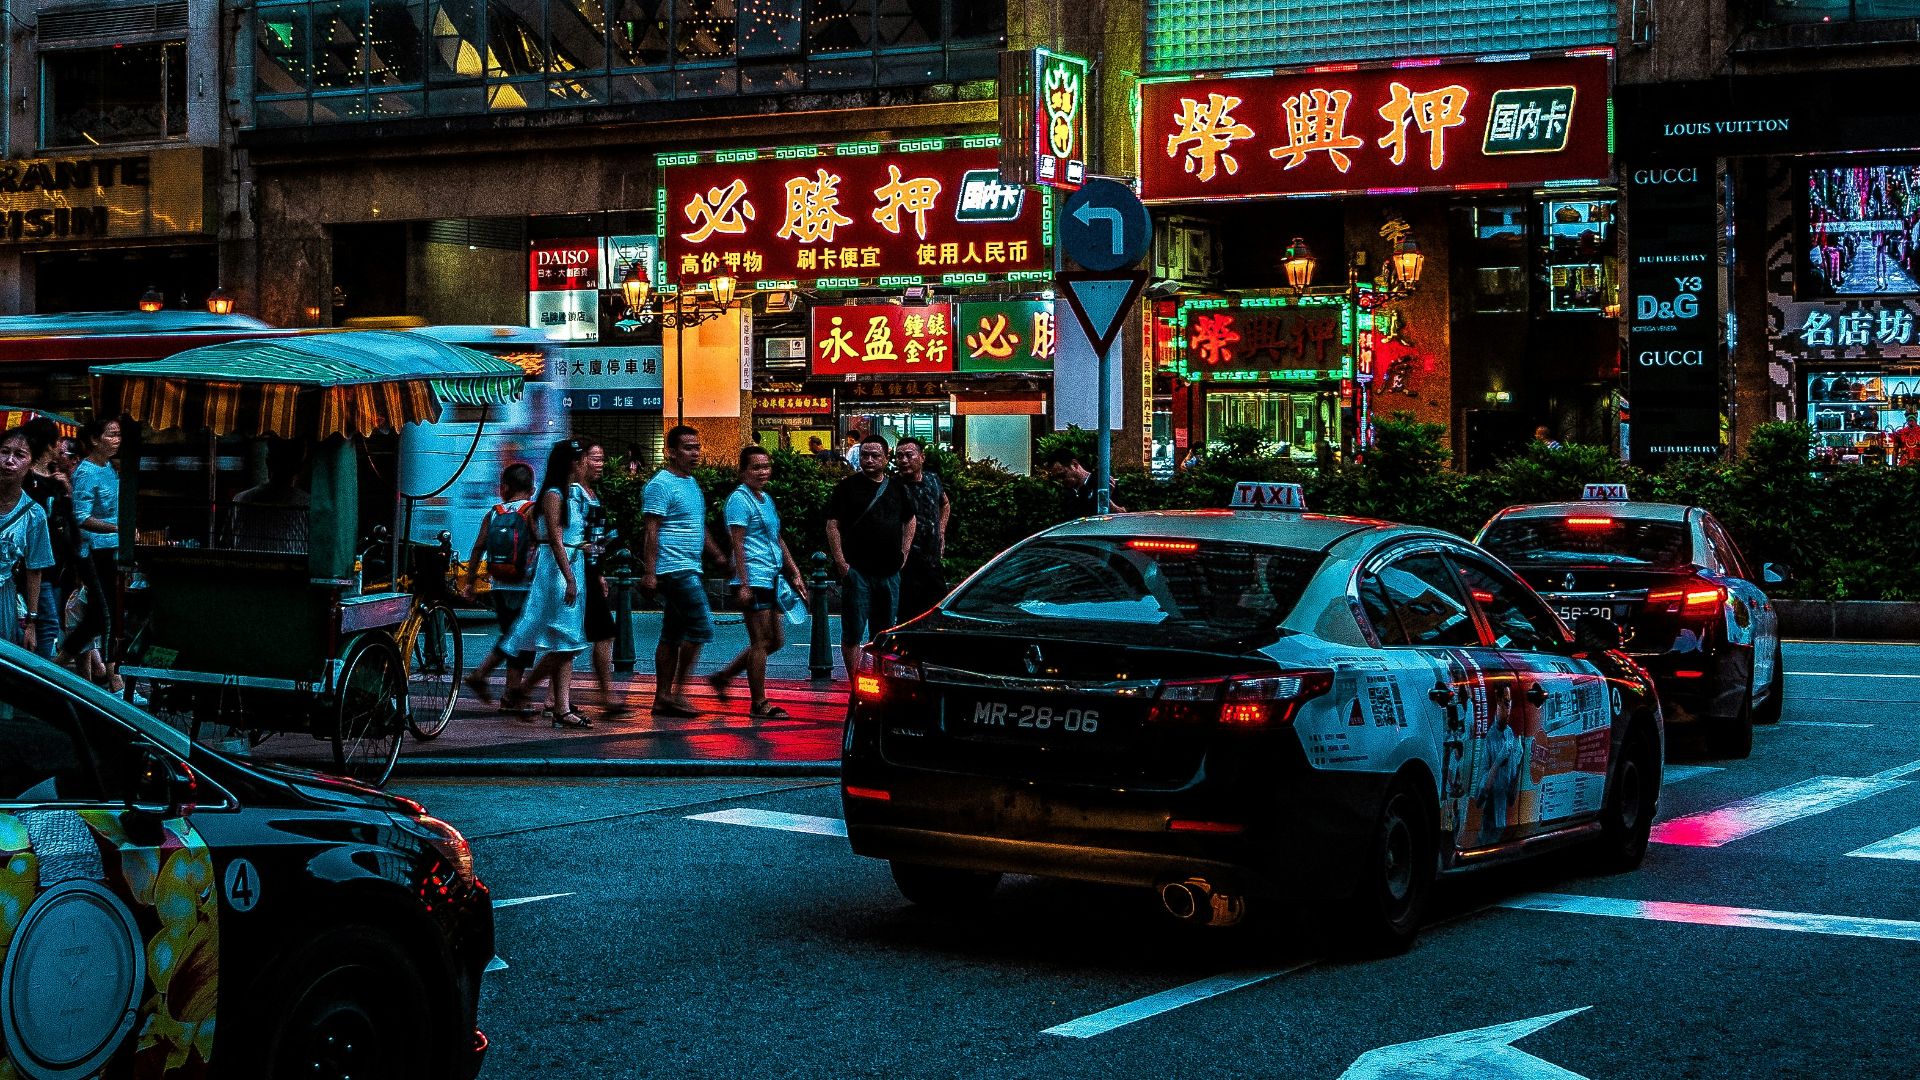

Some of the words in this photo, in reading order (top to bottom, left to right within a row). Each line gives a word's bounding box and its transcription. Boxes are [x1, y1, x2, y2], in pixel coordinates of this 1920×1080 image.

[1166, 82, 1470, 183] 榮興押
[1488, 99, 1568, 143] 国内卡
[1664, 123, 1711, 137] LOUIS
[1716, 119, 1790, 134] VUITTON
[1634, 167, 1698, 185] GUCCI
[680, 164, 941, 244] 必勝押
[961, 179, 1021, 211] 国内卡
[538, 249, 590, 266] DAISO
[680, 250, 764, 275] 高价押物
[797, 246, 882, 271] 刷卡便宜
[916, 240, 1029, 267] 使用人民币
[1638, 254, 1708, 264] BURBERRY
[1674, 276, 1703, 292] Y-3
[1637, 294, 1699, 320] D&G
[818, 315, 899, 364] 永盈
[1190, 313, 1338, 366] 榮興押
[1800, 310, 1913, 346] 名店坊
[902, 339, 949, 364] 金行
[1639, 350, 1703, 366] GUCCI
[1650, 444, 1719, 455] BURBERRY
[1237, 484, 1294, 507] TAXI
[1586, 485, 1625, 499] TAXI
[973, 701, 1101, 734] MR-28-06
[231, 862, 253, 907] 4
